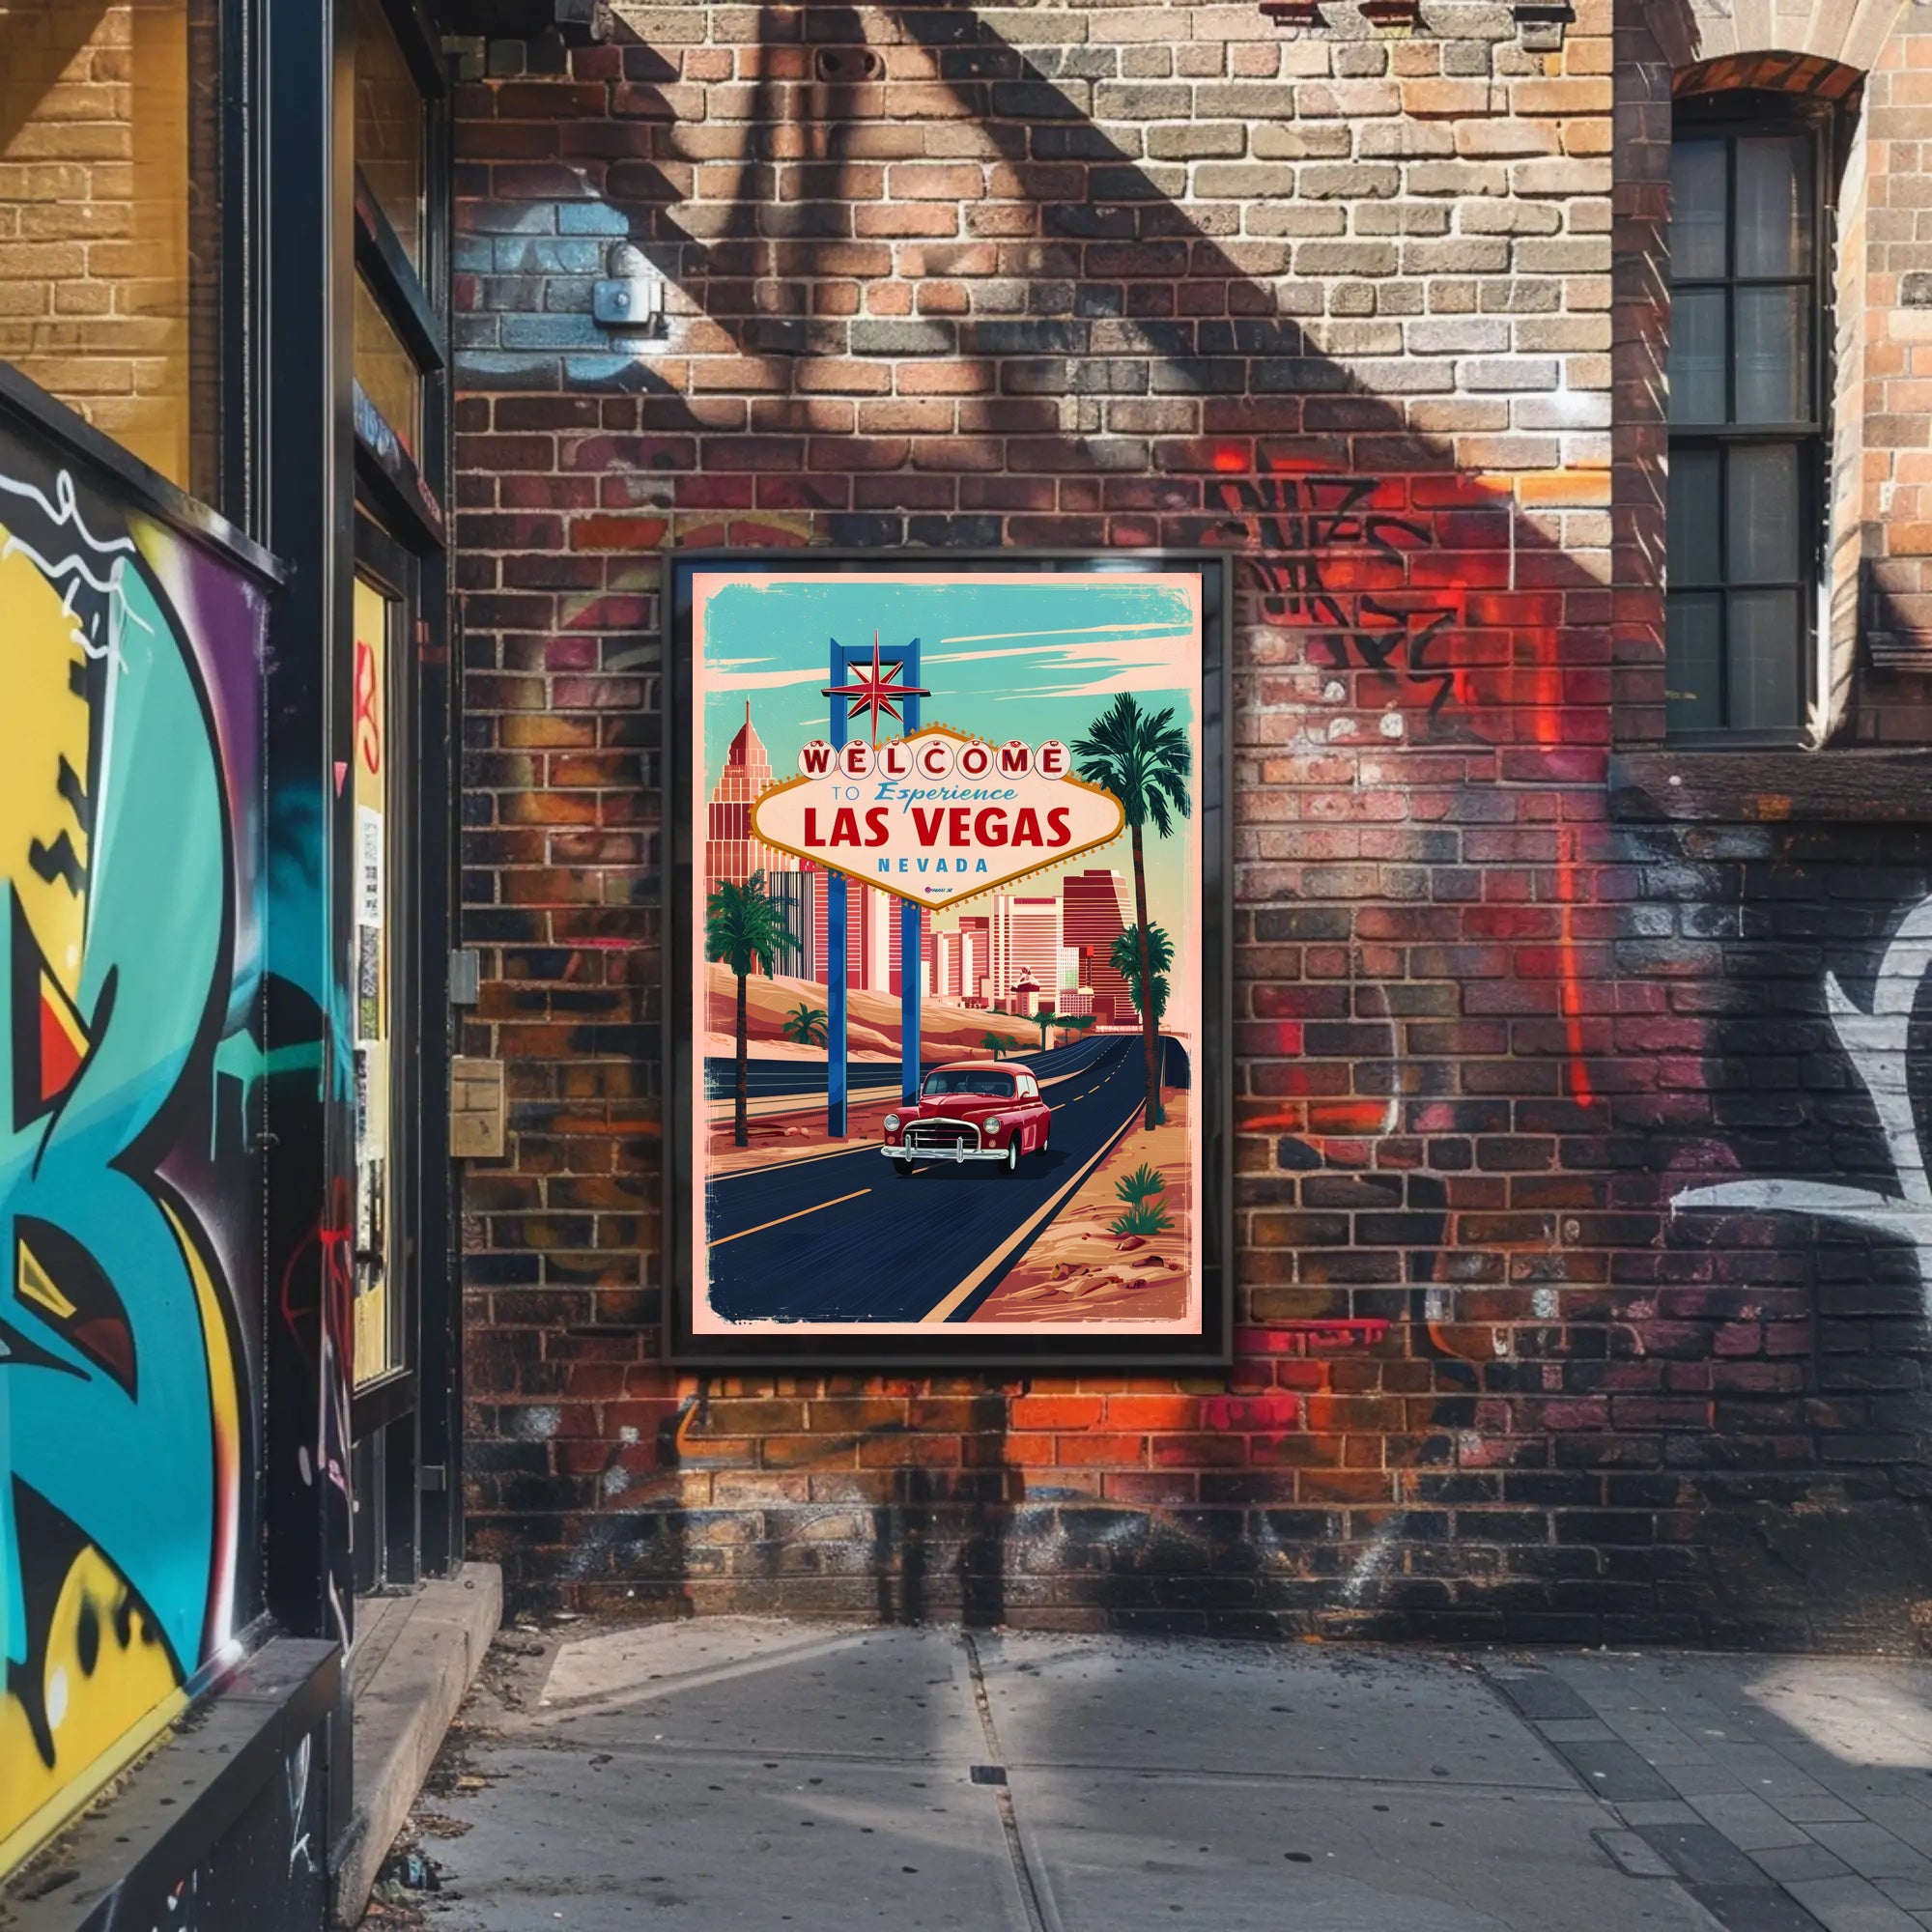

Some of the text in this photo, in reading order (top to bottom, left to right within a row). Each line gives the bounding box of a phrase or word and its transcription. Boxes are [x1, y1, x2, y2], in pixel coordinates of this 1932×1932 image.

[801, 745, 1065, 776] WELCOME
[832, 785, 860, 801] TO
[805, 808, 1071, 847] LAS VEGAS
[878, 857, 987, 873] NEVADA
